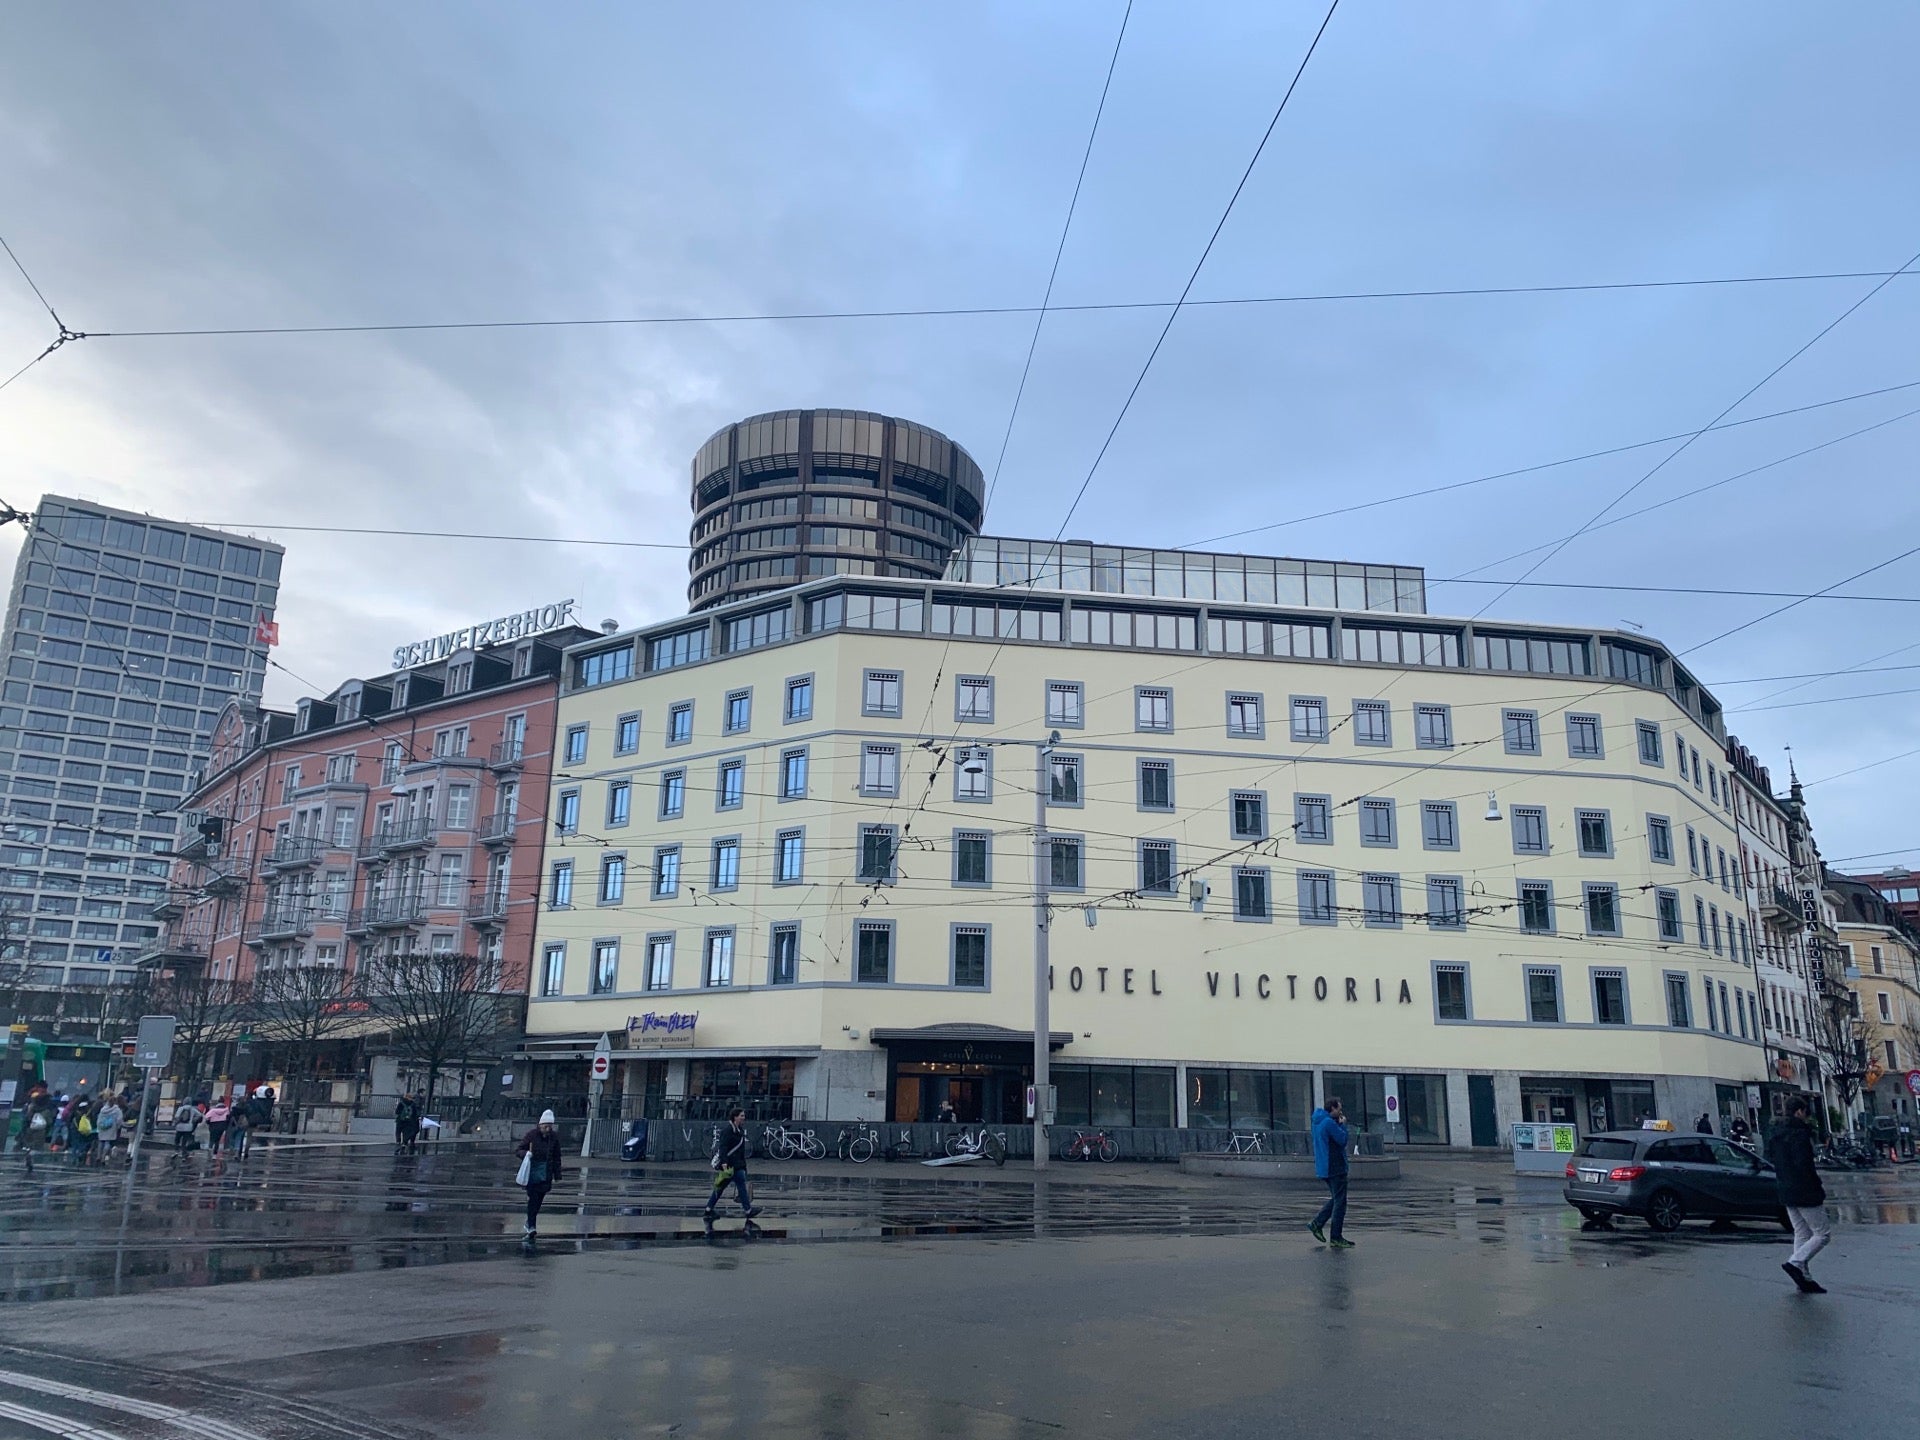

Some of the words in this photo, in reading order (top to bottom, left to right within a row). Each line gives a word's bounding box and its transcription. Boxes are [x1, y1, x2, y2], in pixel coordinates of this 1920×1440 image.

[391, 599, 574, 669] SCHWEIZERHOF
[1803, 890, 1816, 931] GAIA
[1810, 939, 1823, 991] HOTEL
[1207, 972, 1412, 1003] VICTORIA
